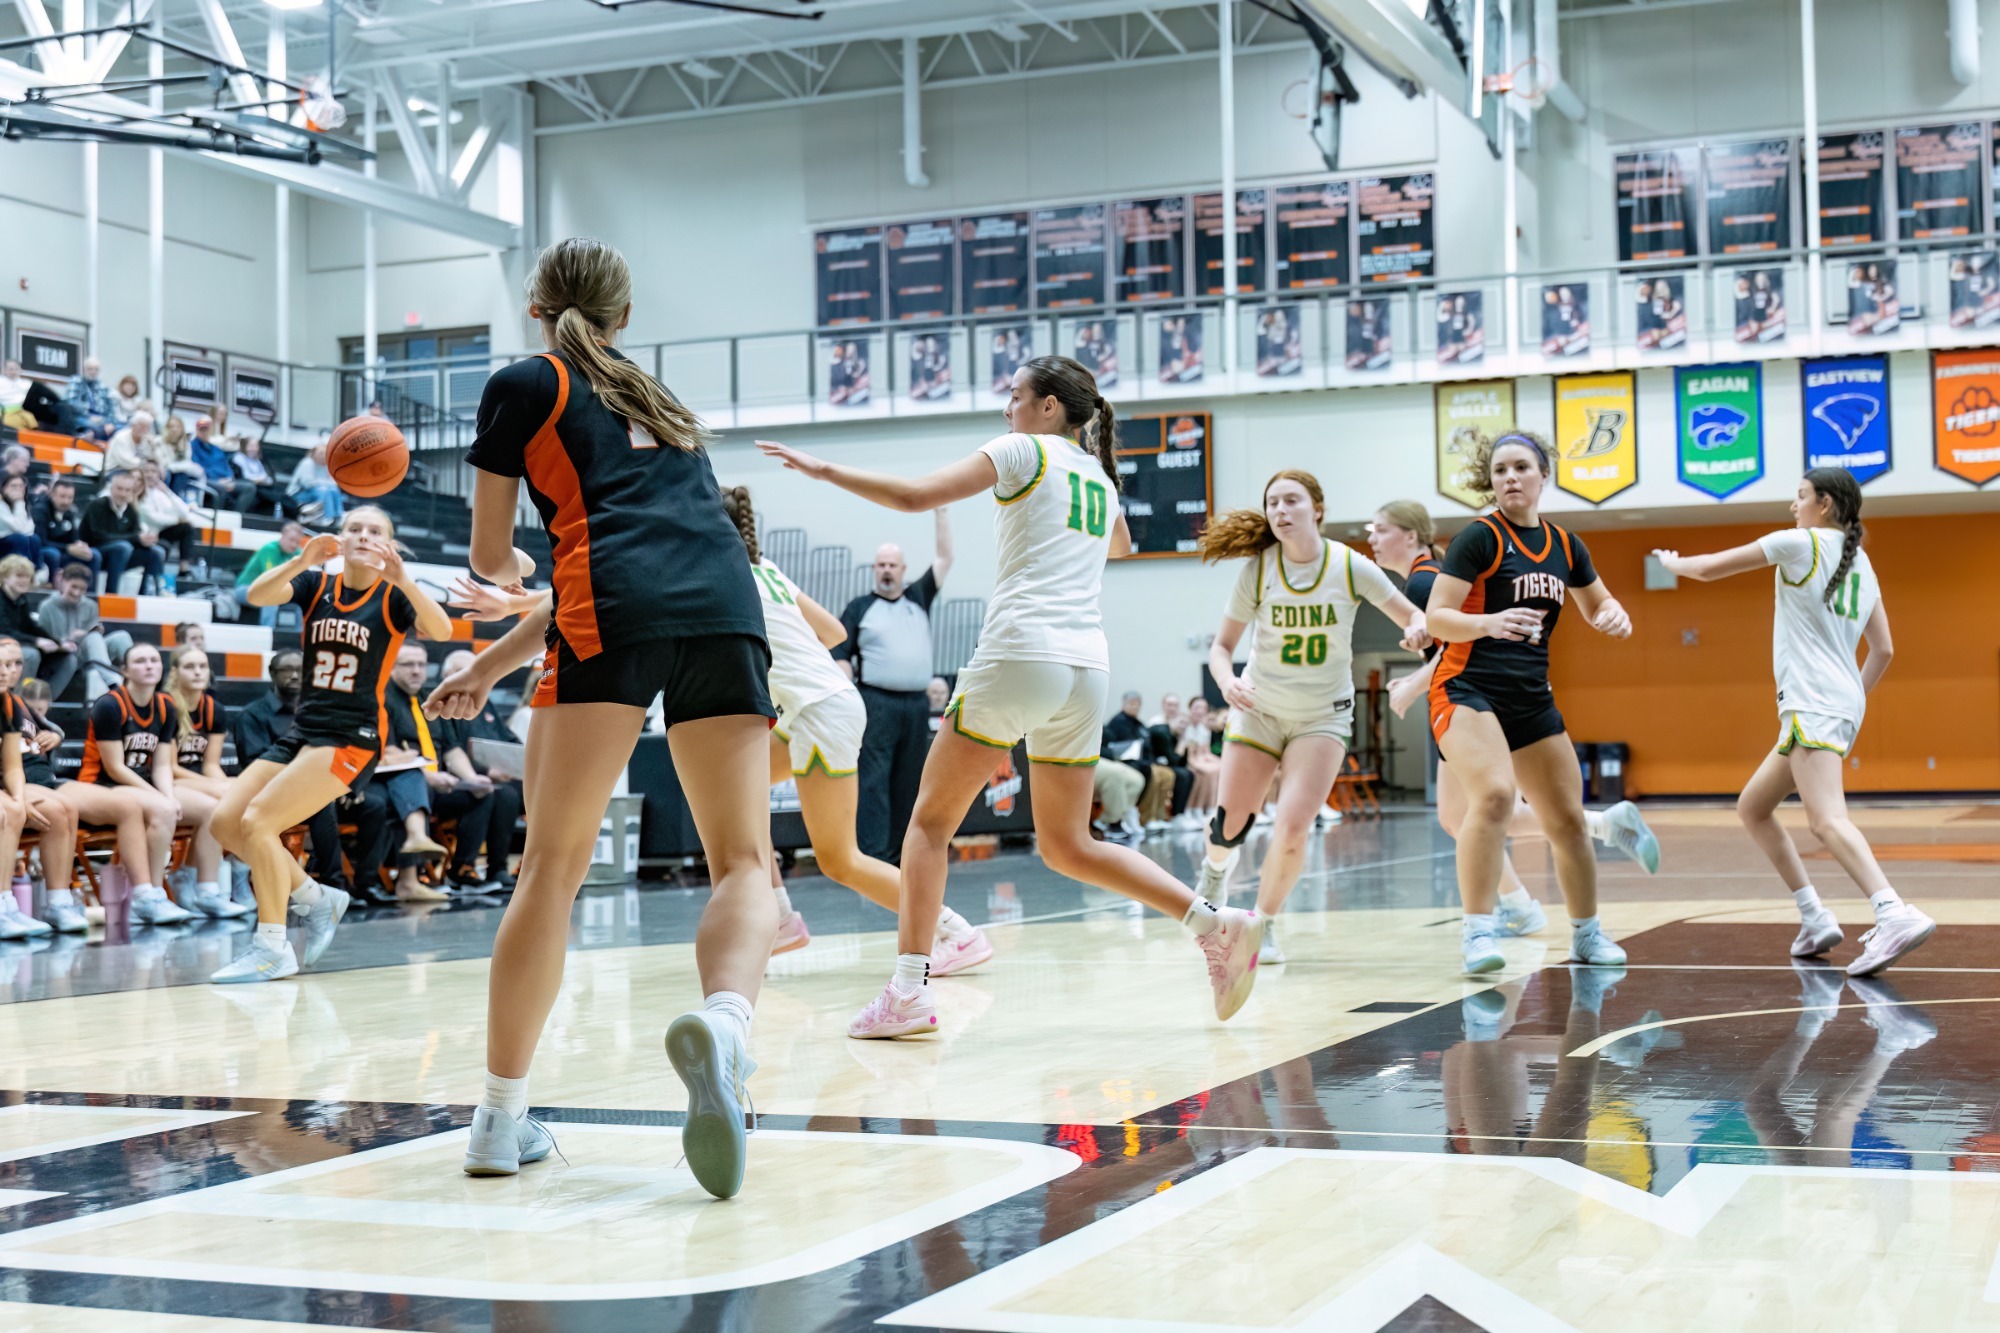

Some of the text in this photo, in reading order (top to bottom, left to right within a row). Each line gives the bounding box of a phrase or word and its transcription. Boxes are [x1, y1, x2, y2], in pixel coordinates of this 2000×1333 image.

[36, 345, 68, 368] TEAM
[1687, 376, 1749, 395] EAGAN
[1807, 369, 1883, 387] EASTVIEW
[1157, 450, 1201, 469] GUEST
[1685, 457, 1757, 475] WILDCATS
[1572, 465, 1619, 480] BLAZE
[1066, 470, 1107, 538] 10
[752, 566, 795, 605] 15
[1512, 571, 1565, 606] TIGERS
[1272, 603, 1338, 628] EDINA
[311, 618, 371, 652] TIGERS
[1281, 632, 1328, 667] 20
[312, 650, 358, 693] 22
